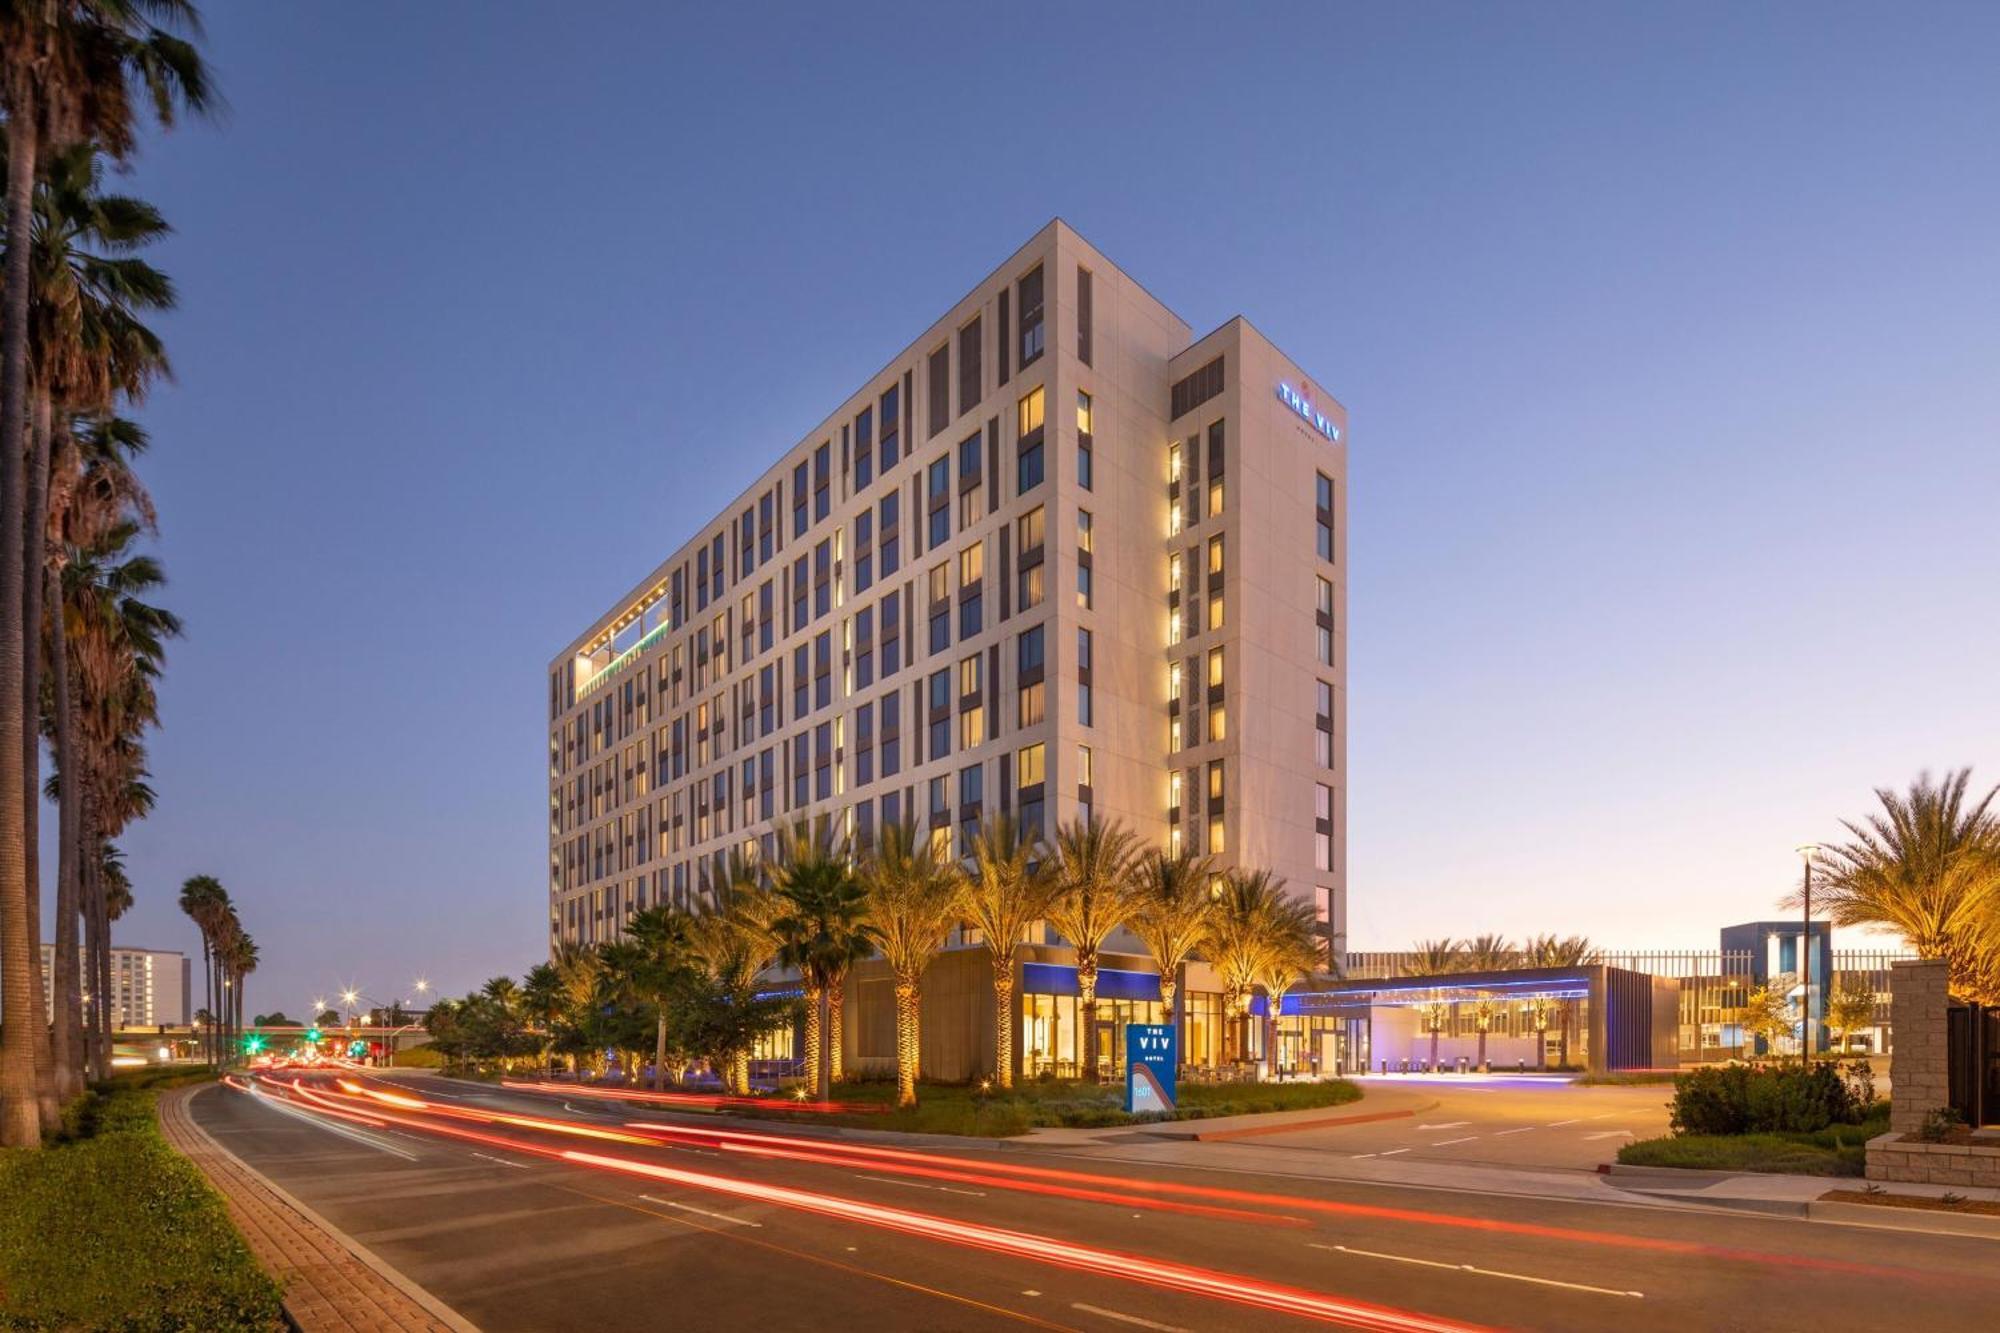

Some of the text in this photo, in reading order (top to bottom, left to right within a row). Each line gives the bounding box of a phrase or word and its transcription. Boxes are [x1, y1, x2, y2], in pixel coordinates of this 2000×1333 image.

[1280, 383, 1309, 417] THE
[1315, 412, 1339, 441] VIV
[1140, 1037, 1169, 1050] VIV
